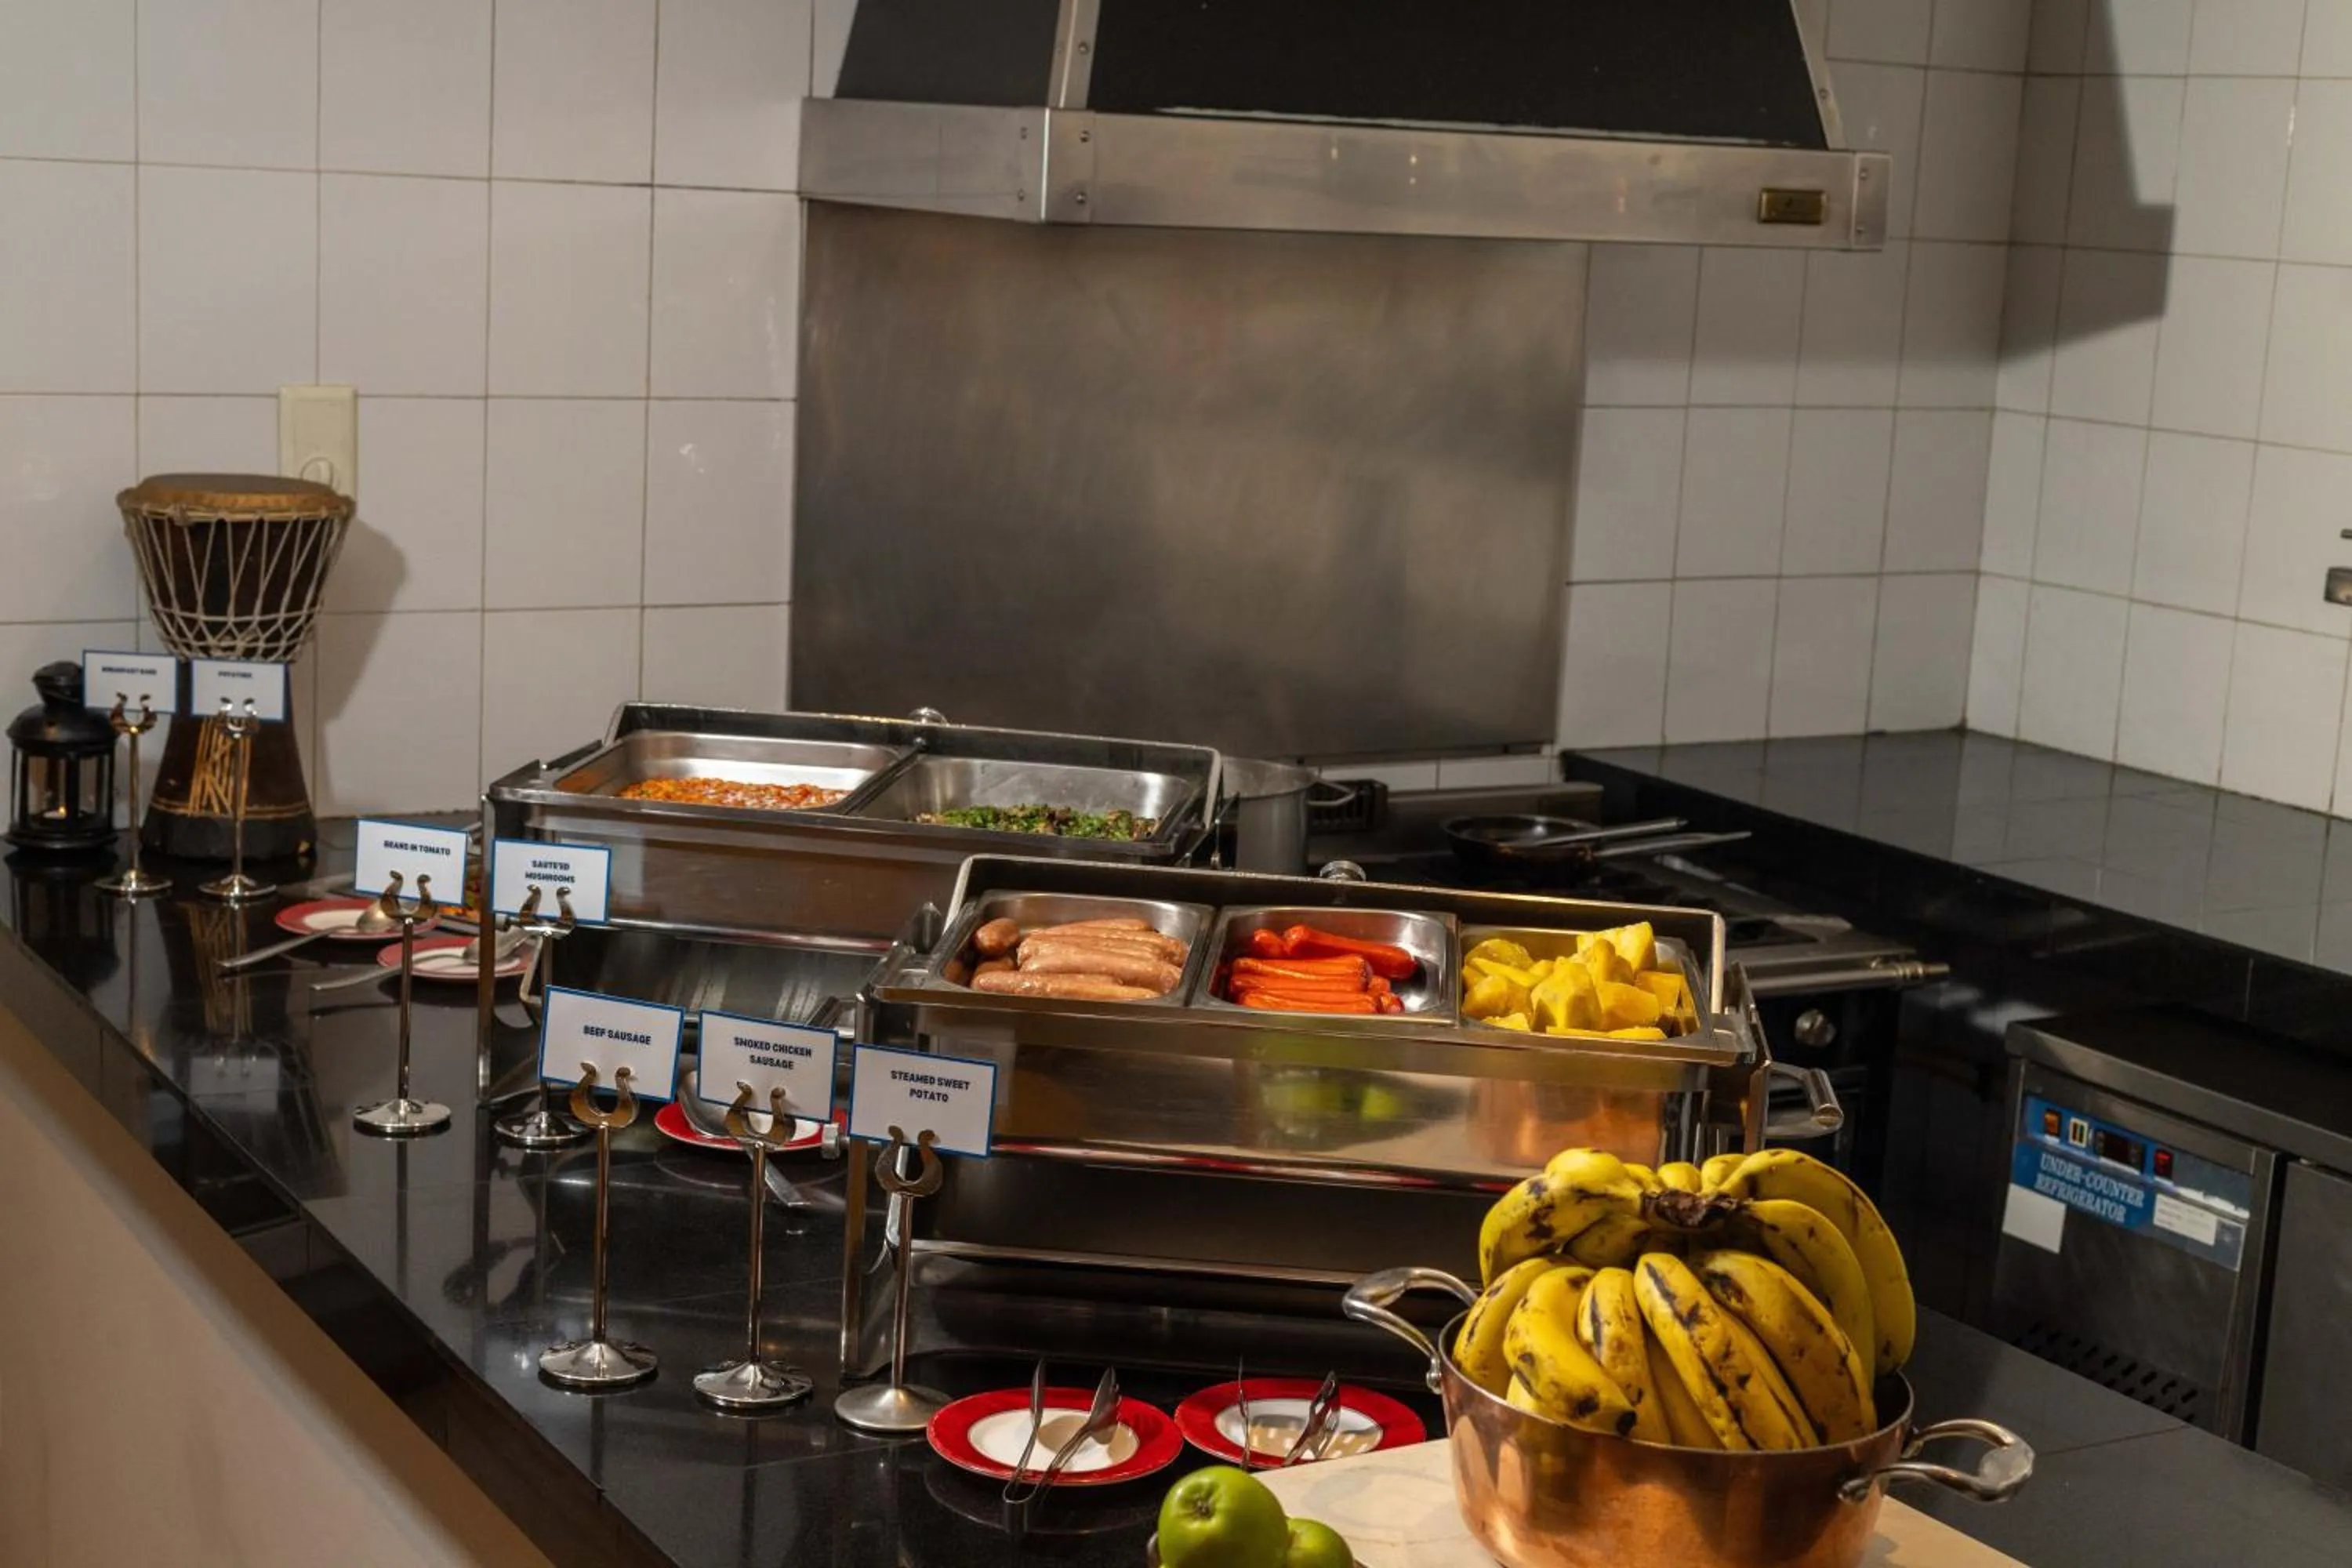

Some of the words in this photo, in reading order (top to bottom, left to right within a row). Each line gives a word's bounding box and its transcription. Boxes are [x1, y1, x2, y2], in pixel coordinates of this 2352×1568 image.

[383, 840, 408, 851] BEANS
[410, 844, 418, 852] IN
[419, 844, 451, 855] TOMATO
[524, 871, 575, 884] MUSHROOMS
[583, 1025, 606, 1037] BEEF
[608, 1029, 652, 1045] SAUSAGE
[734, 1036, 771, 1052] SMOKED
[772, 1042, 812, 1058] CHICKEN
[750, 1054, 794, 1070] SAUSAGE
[891, 1070, 935, 1086] STEAMED
[937, 1077, 971, 1091] SWEET
[909, 1088, 949, 1102] POTATO
[2040, 1152, 2145, 1208] UNDER-COUNTER
[2034, 1173, 2127, 1223] REFRIGERATOR
